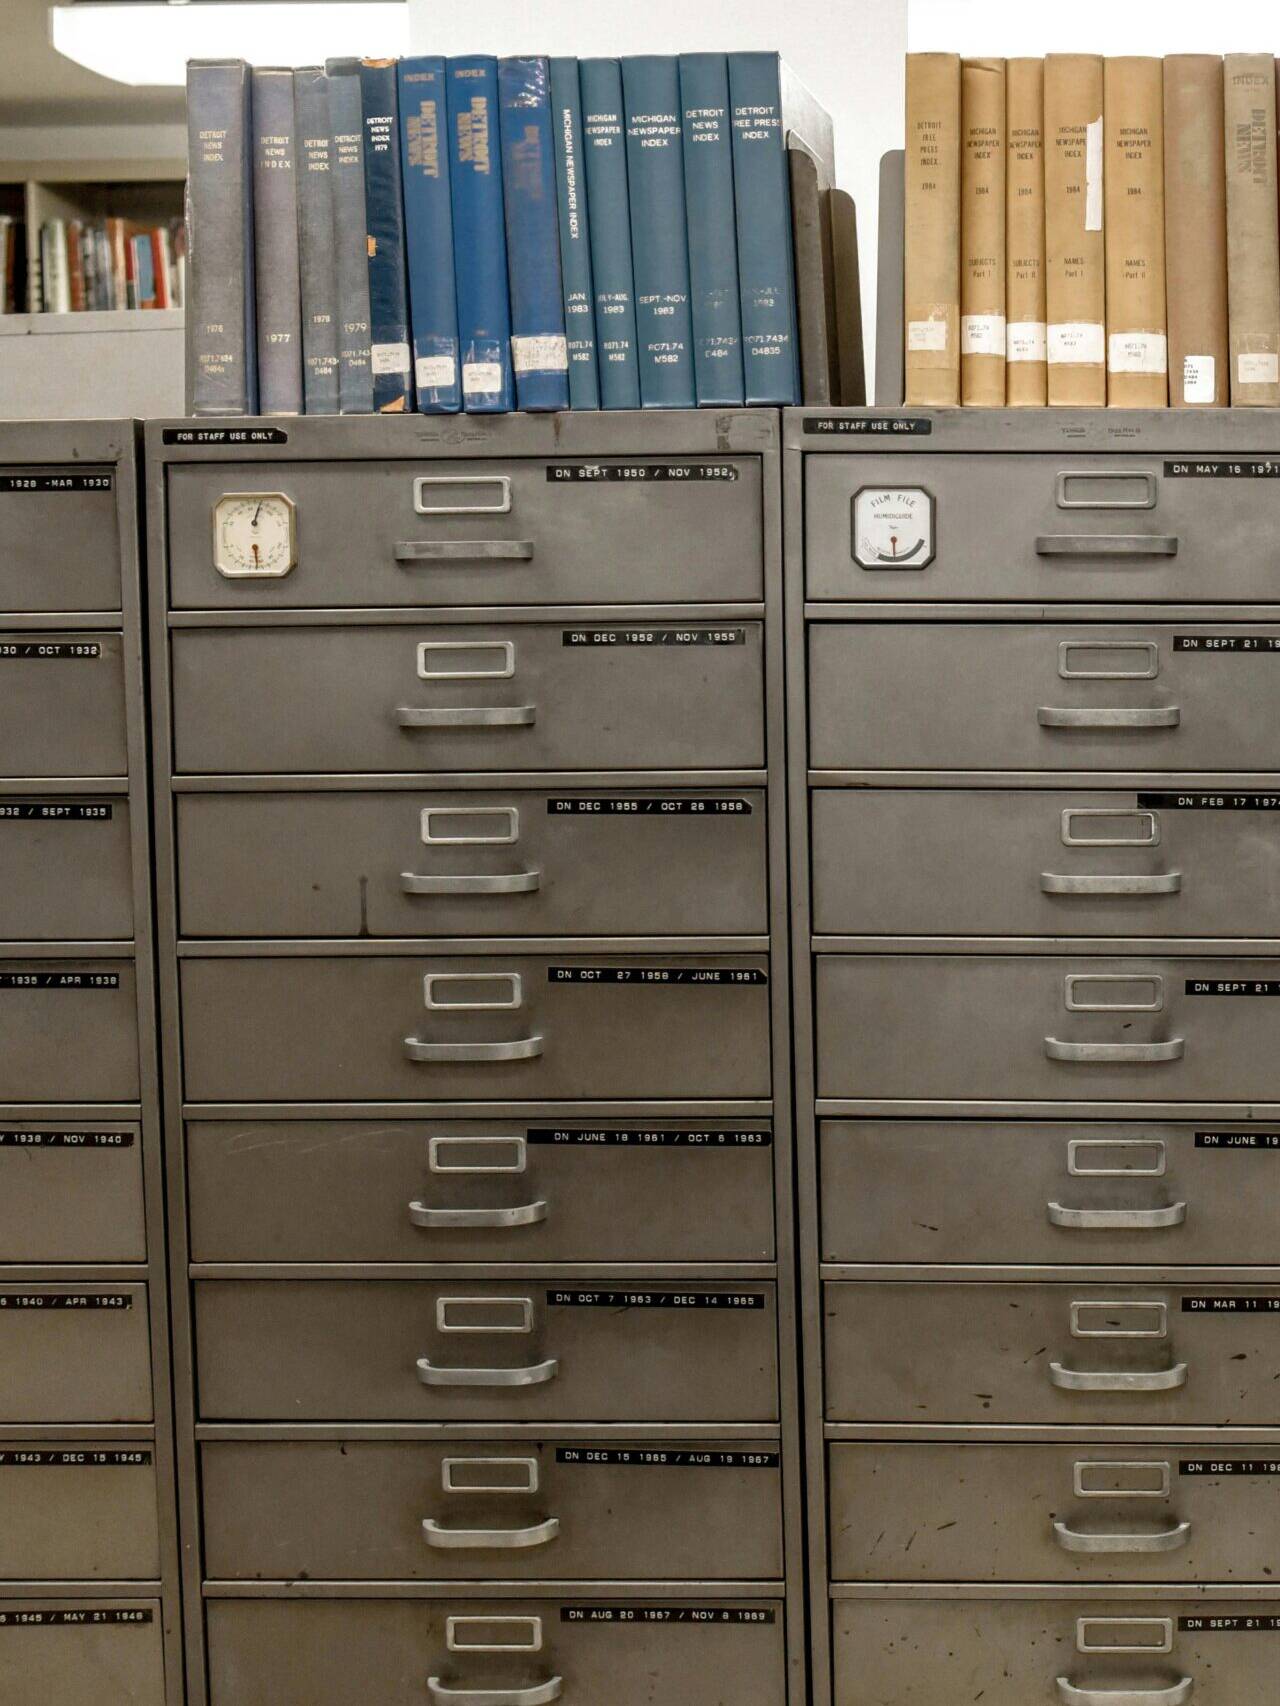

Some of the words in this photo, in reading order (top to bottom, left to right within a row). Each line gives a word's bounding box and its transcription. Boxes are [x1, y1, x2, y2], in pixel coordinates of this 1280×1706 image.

[686, 109, 724, 118] DETROIT
[736, 107, 774, 116] DETROIT
[632, 115, 676, 124] MICHIGAN
[563, 109, 573, 154] MICHIGAN
[742, 131, 769, 139] INDEX
[693, 134, 720, 142] INDEX
[642, 138, 668, 147] INDEX
[261, 160, 290, 168] INDEX
[566, 155, 577, 210] NEWSPAPER
[569, 212, 578, 240] INDEX
[568, 293, 585, 301] JAN
[568, 305, 588, 313] 1983
[604, 306, 624, 314] 1983
[654, 307, 674, 315] 1983
[344, 323, 367, 332] 1979
[266, 334, 290, 342] 1977
[654, 354, 678, 363] M582
[230, 432, 246, 440] USE
[871, 494, 891, 507] FILM
[897, 494, 916, 507] FILE
[572, 634, 586, 642] DN
[676, 633, 697, 641] NOV
[71, 647, 97, 655] 1932
[557, 802, 571, 810] DN
[1256, 984, 1267, 992] 21
[64, 1135, 84, 1143] NOV
[674, 1296, 695, 1304] DEC
